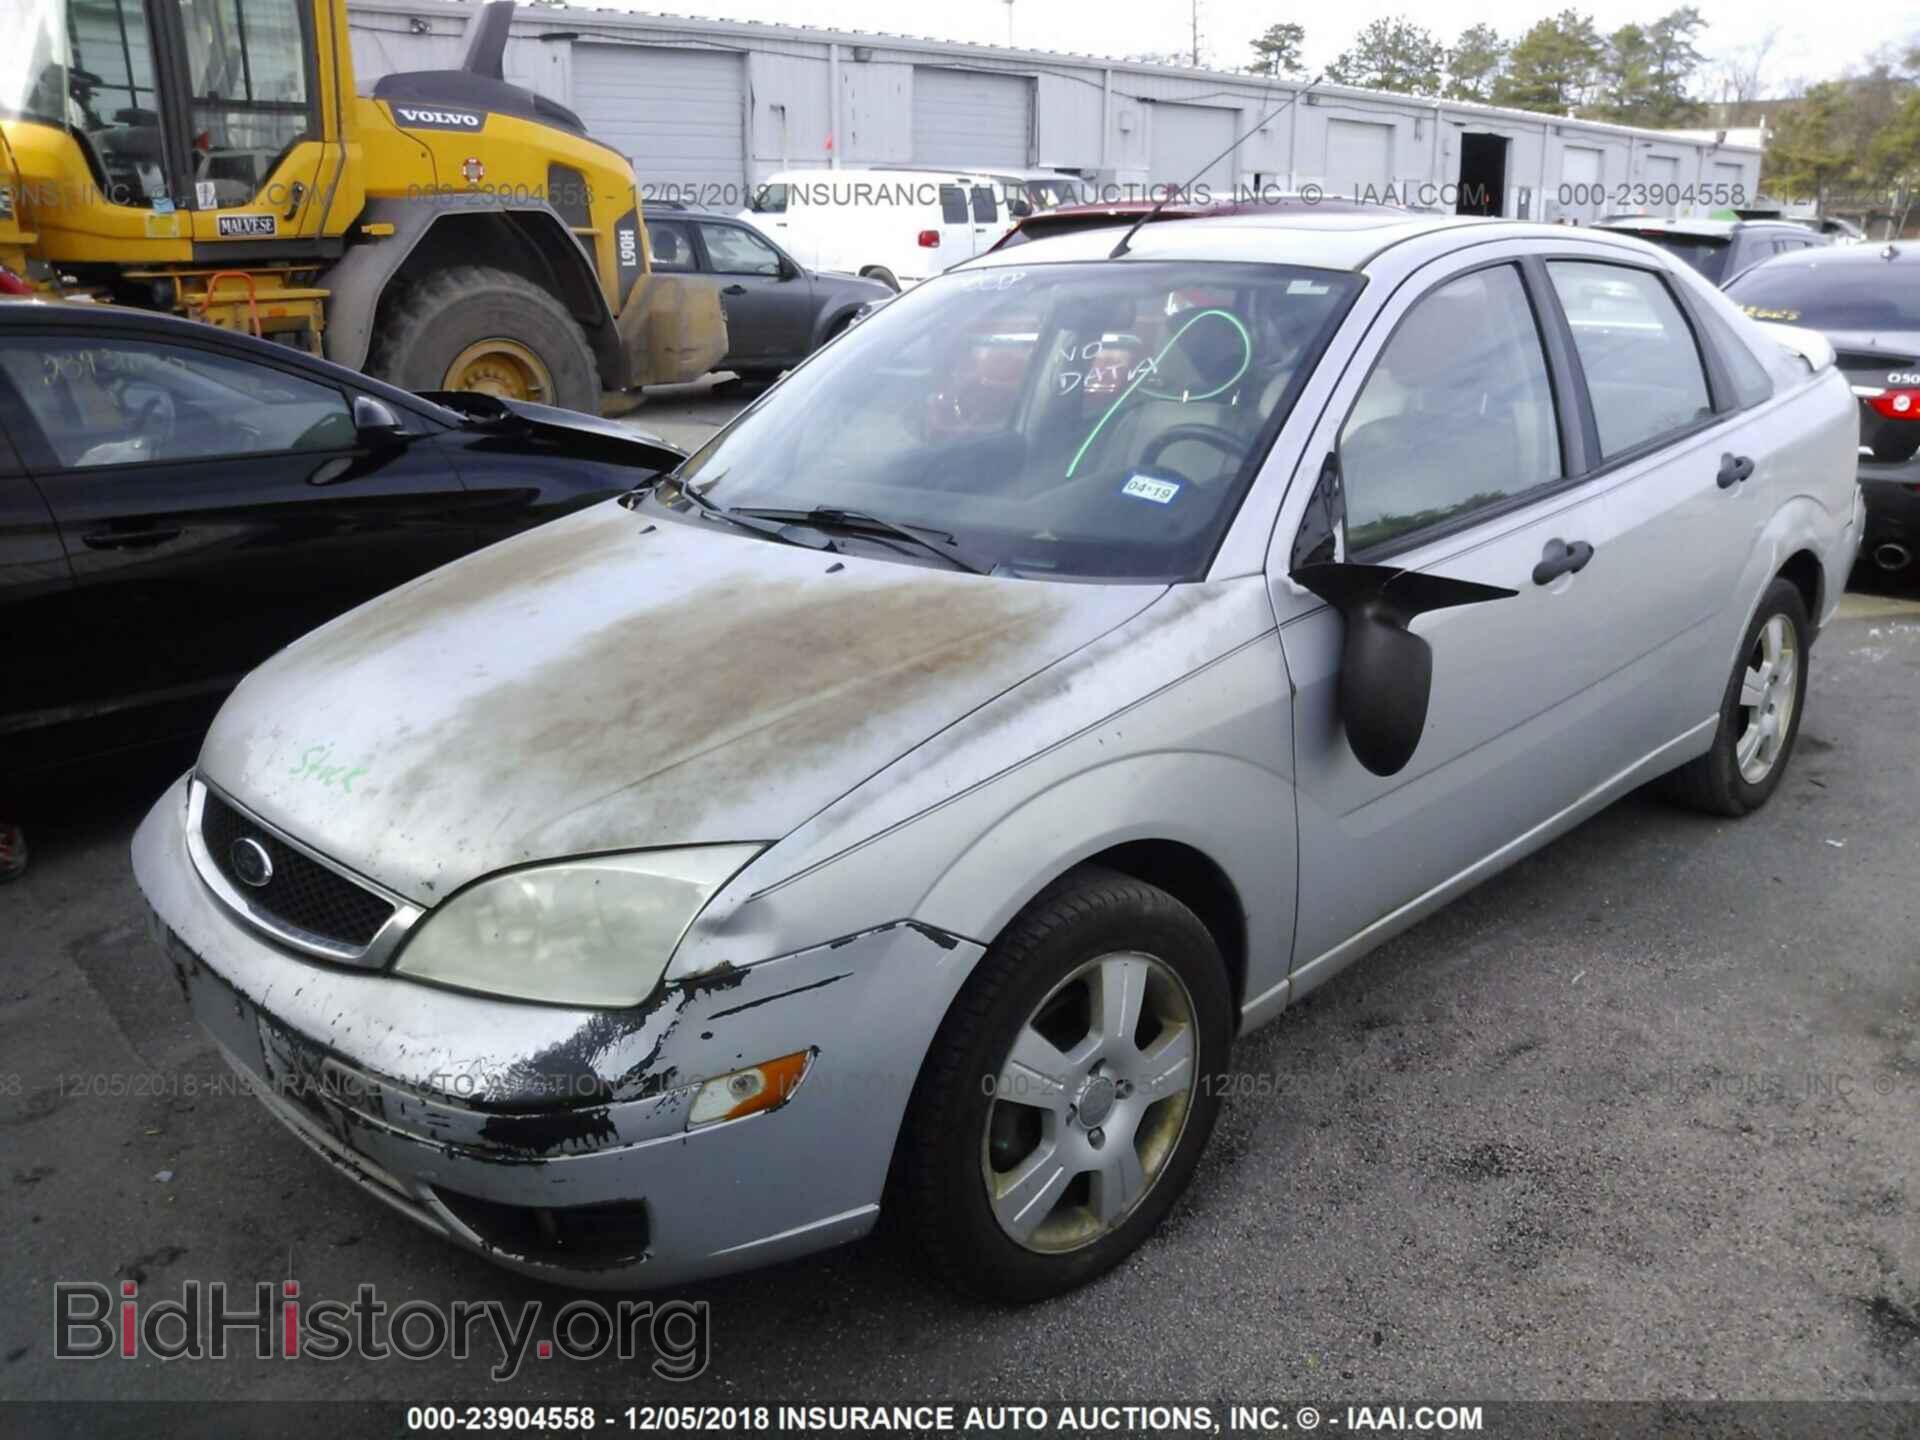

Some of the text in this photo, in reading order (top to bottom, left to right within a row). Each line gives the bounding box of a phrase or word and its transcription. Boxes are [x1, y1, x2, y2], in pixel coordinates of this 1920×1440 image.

[397, 108, 479, 127] VOLVO
[219, 214, 275, 233] MALVESE
[619, 229, 637, 267] L90H
